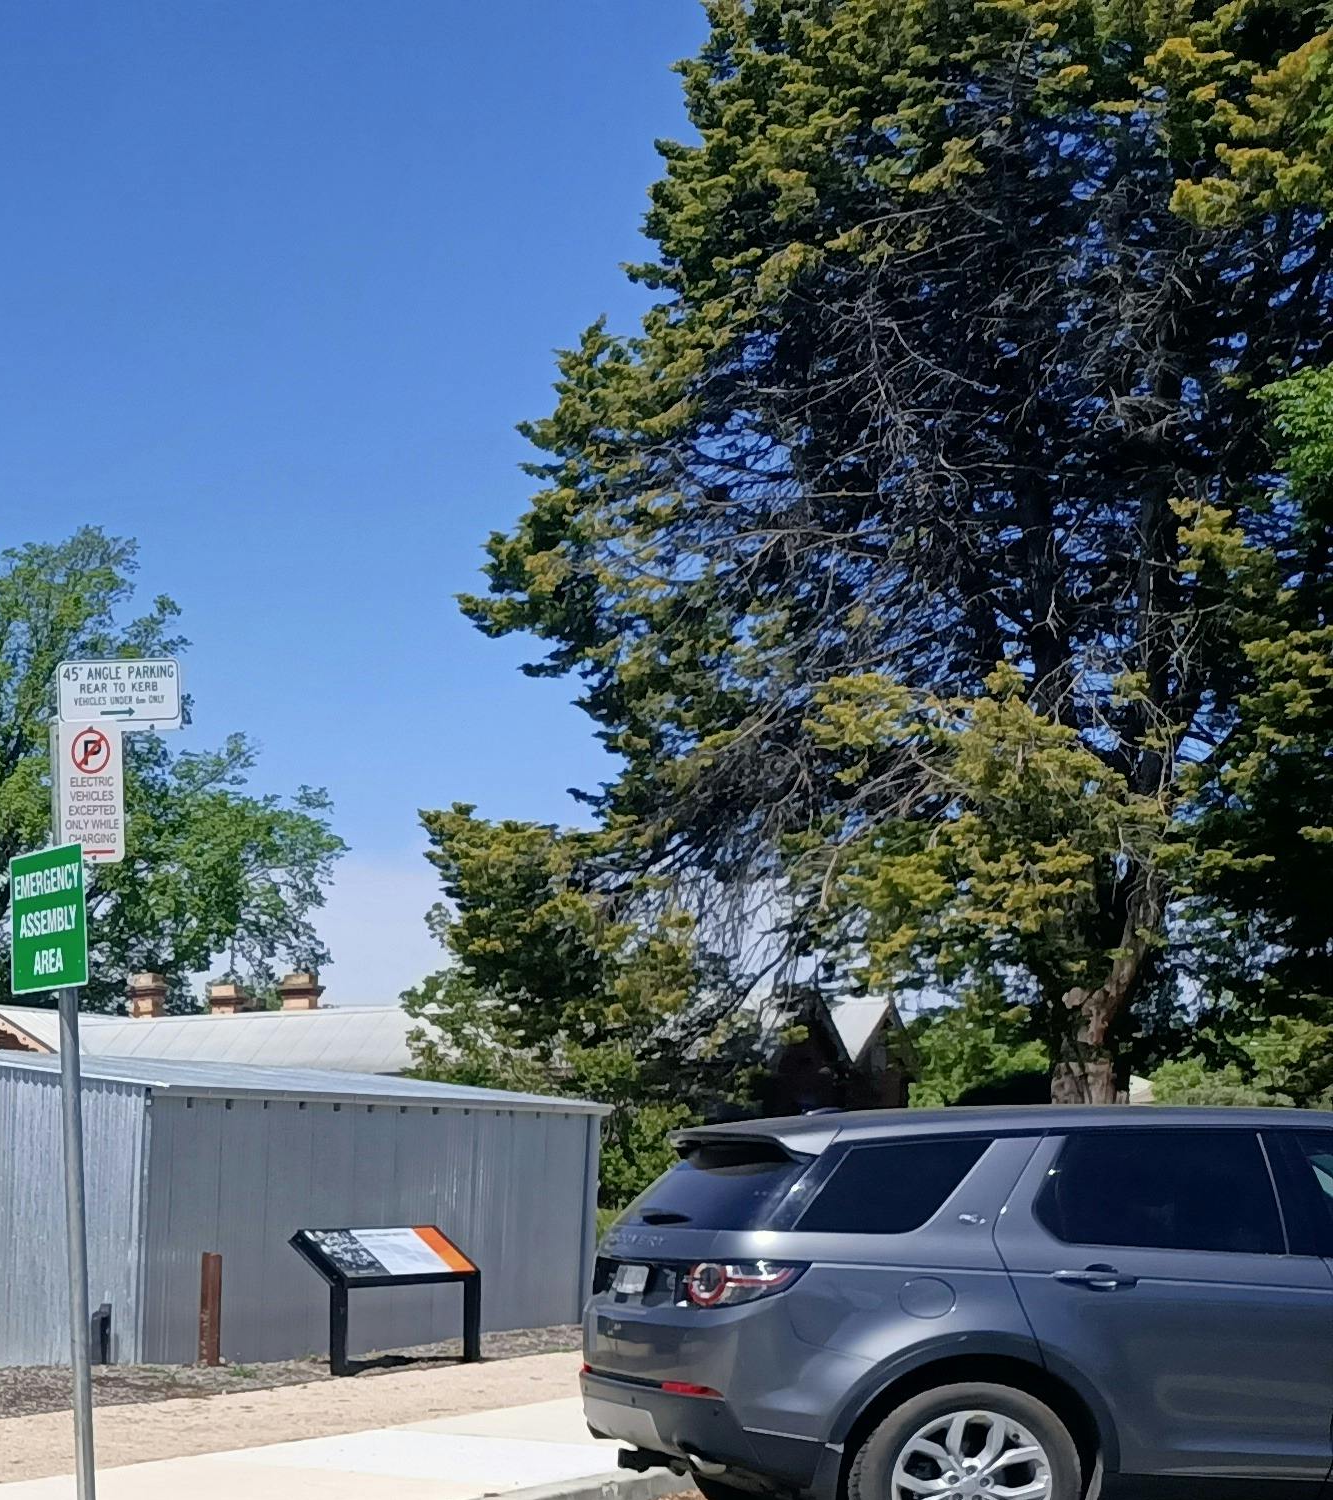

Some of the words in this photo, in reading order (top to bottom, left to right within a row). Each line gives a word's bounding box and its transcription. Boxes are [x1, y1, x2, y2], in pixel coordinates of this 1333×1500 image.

[87, 666, 122, 681] ANGLE
[128, 664, 174, 679] PARKING
[79, 683, 107, 694] REAR
[113, 682, 126, 693] TO
[132, 681, 158, 692] KERB
[73, 696, 107, 706] VEHICLES
[110, 695, 133, 705] UNDER
[149, 695, 165, 704] ONLY
[70, 776, 114, 787] ELECTRIC
[70, 790, 114, 801] VEHICLES
[68, 804, 116, 816] EXCEPTED
[65, 819, 89, 830] ONLY
[92, 818, 119, 829] WHILE
[68, 833, 116, 843] CHARGING
[14, 862, 79, 900] EMERGENCY
[20, 904, 76, 939] ASSEMBLY
[34, 947, 64, 976] AREA
